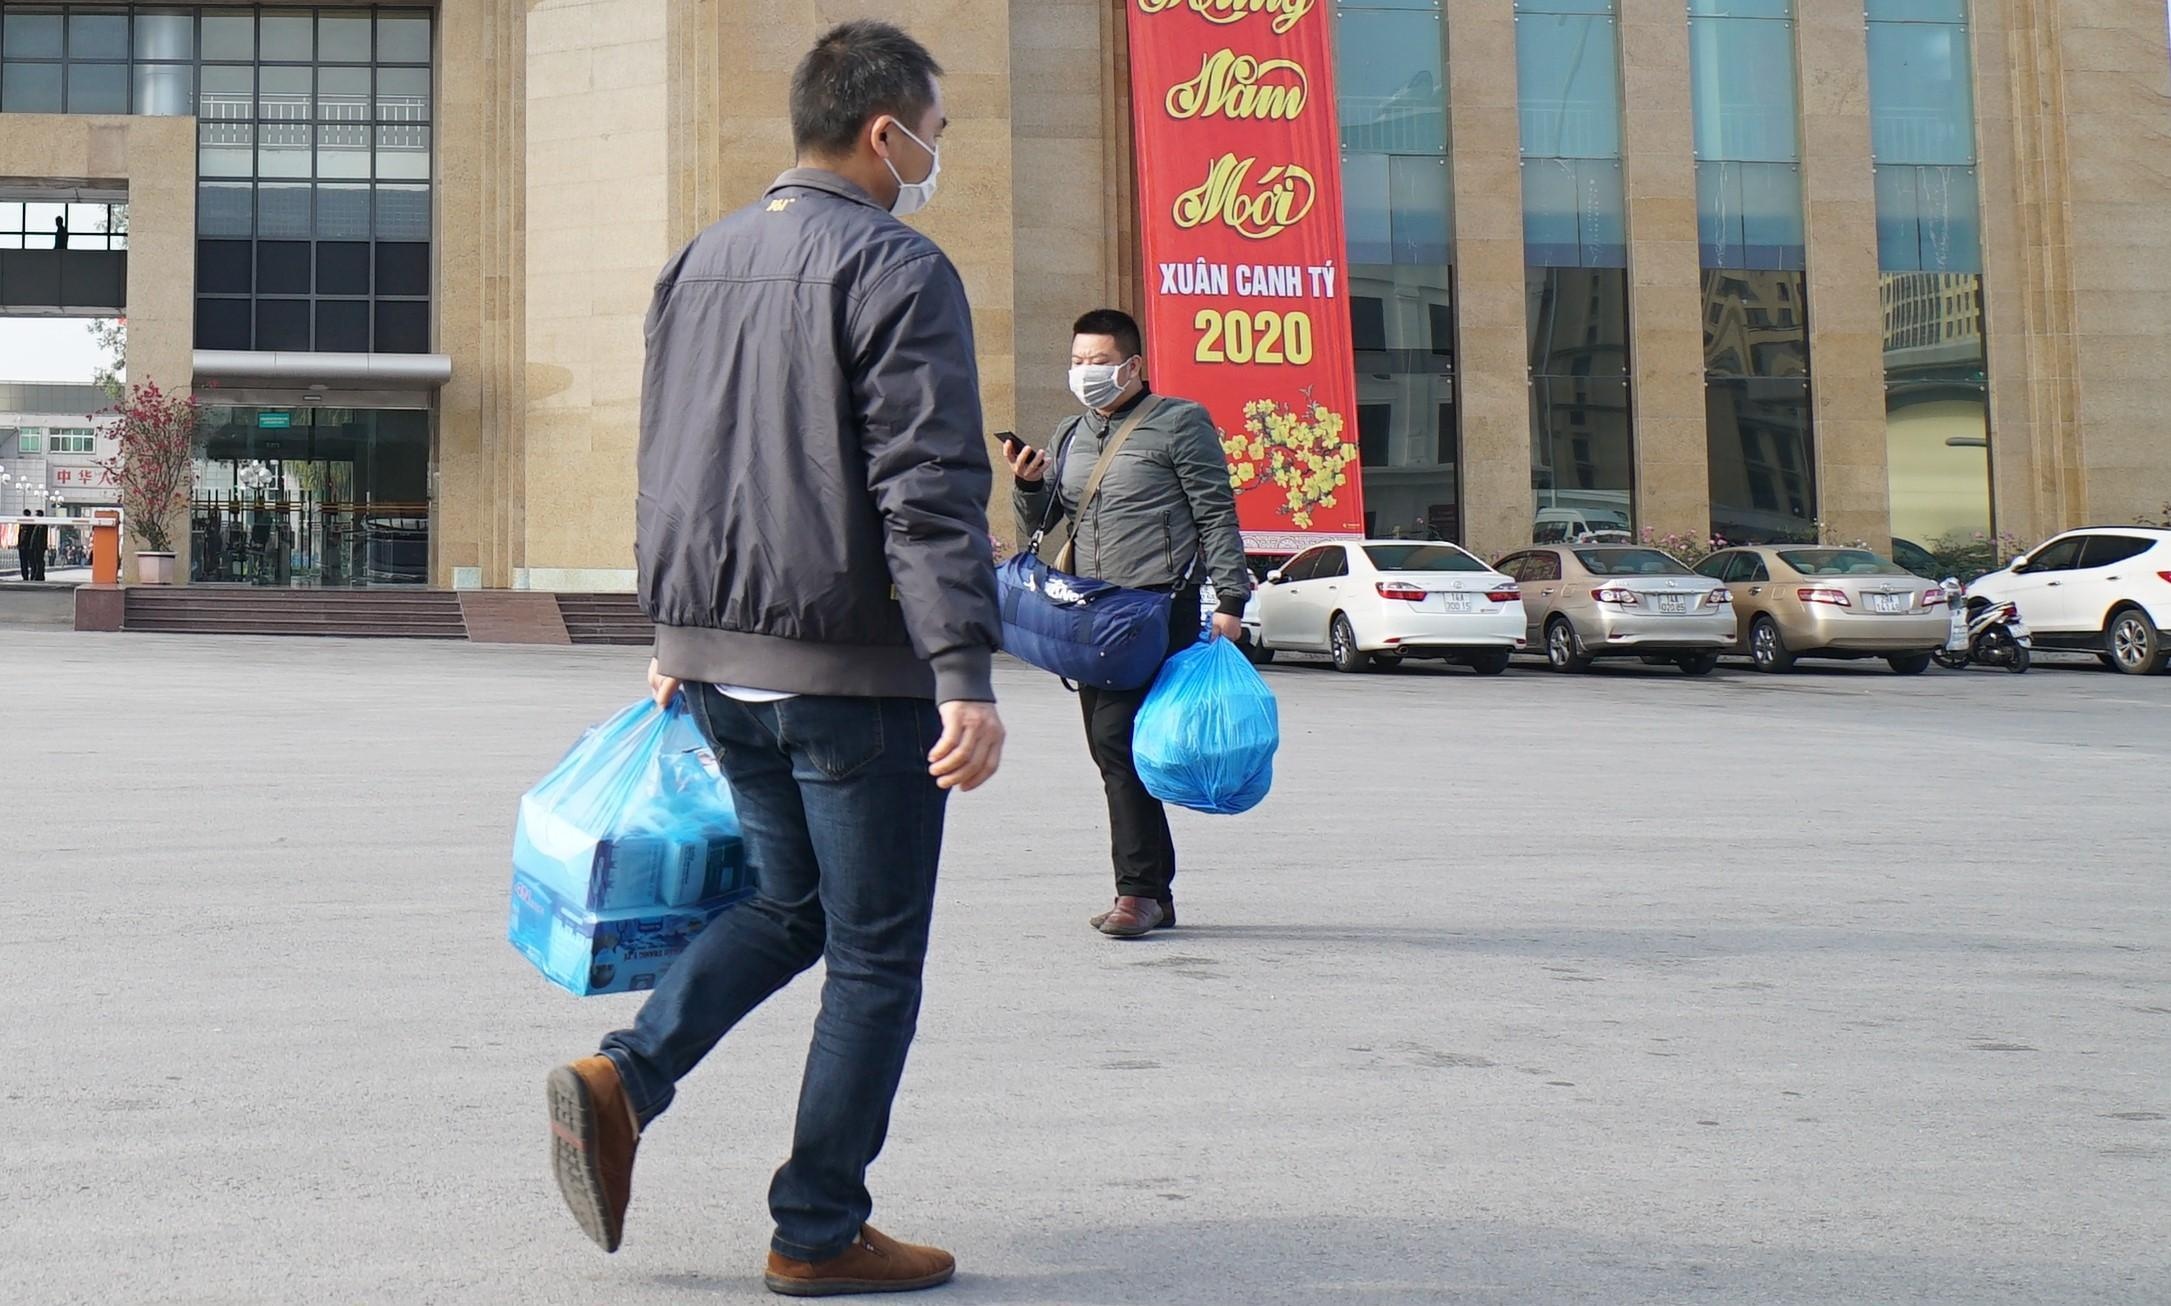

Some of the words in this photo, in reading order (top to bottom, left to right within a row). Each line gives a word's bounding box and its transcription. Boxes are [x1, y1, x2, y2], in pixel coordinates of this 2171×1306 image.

[1165, 48, 1308, 120] Năm
[1172, 152, 1316, 239] Mới
[1159, 256, 1229, 296] XUÂN
[1235, 264, 1303, 298] CANH
[1307, 259, 1336, 299] TÝ
[1194, 309, 1313, 366] 2020
